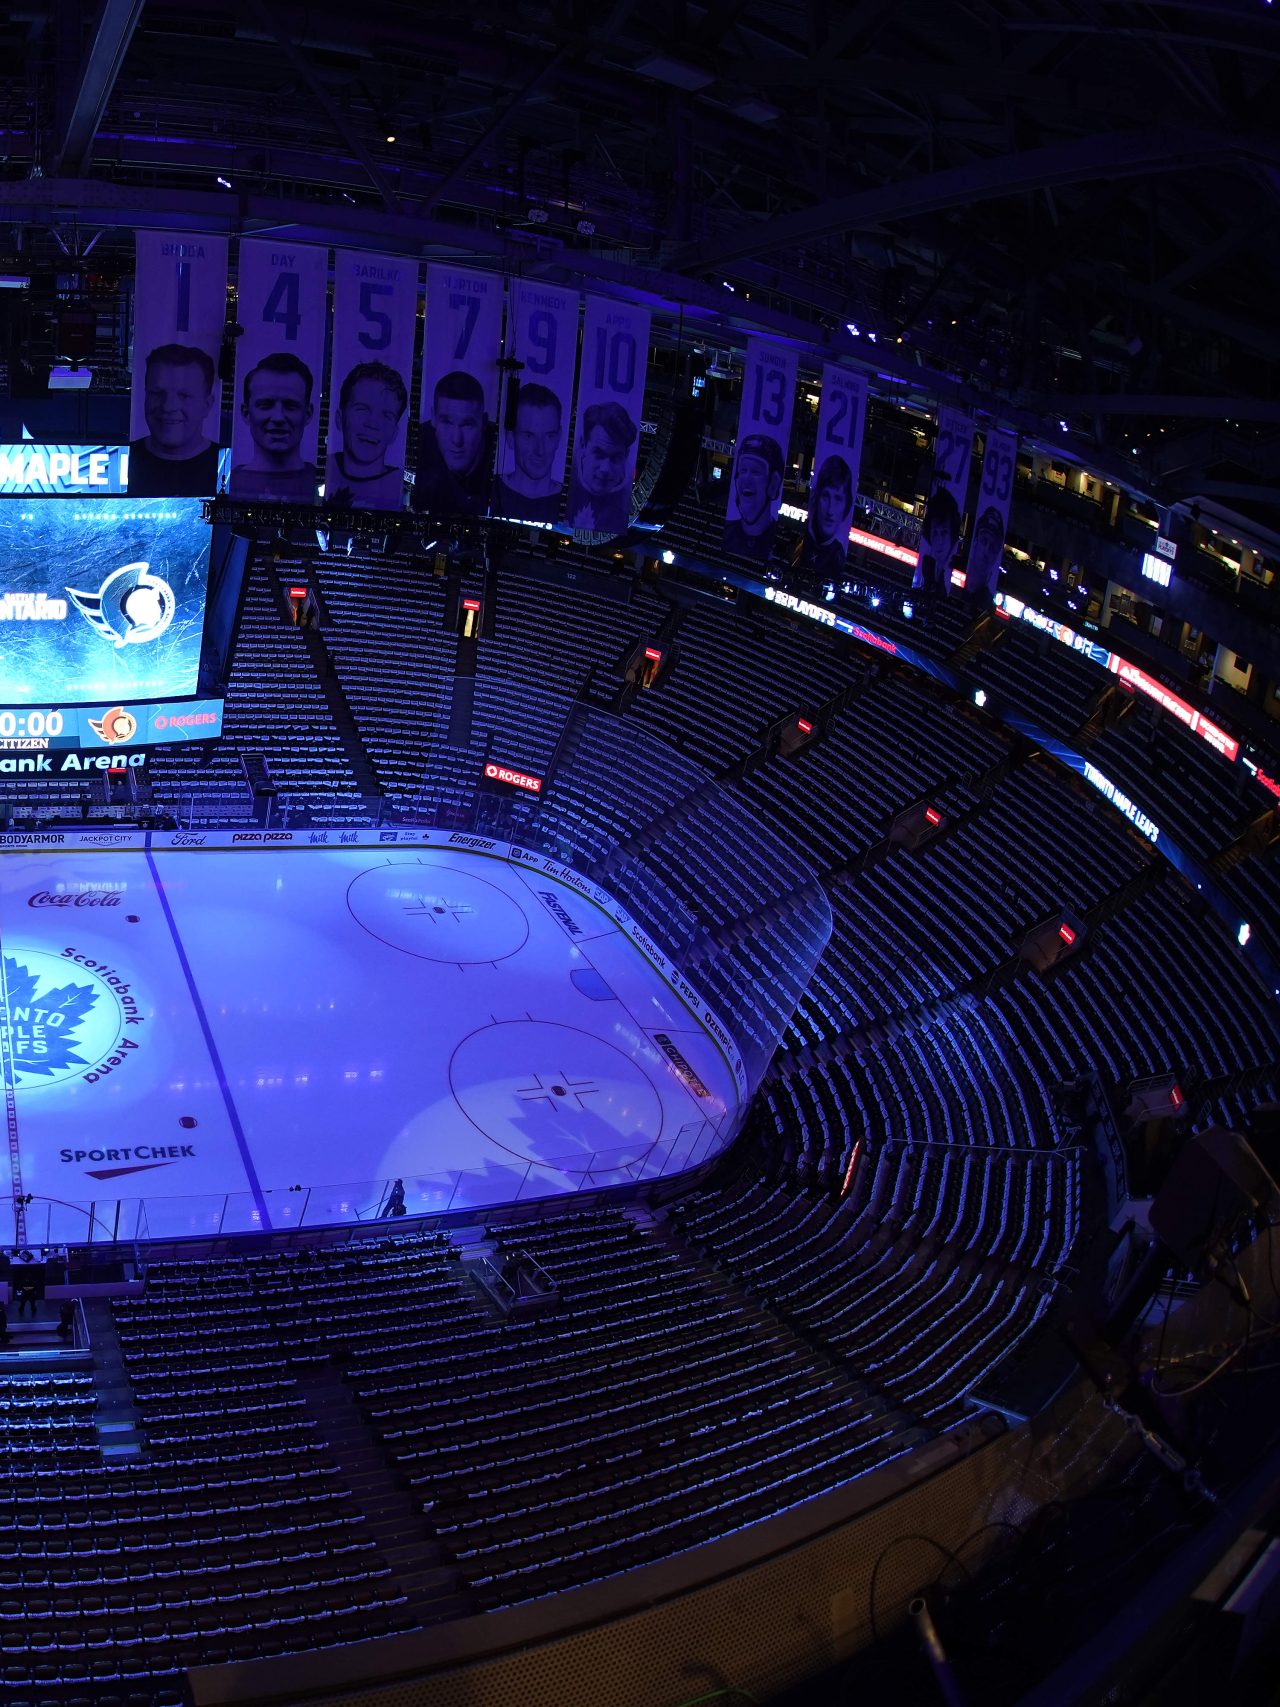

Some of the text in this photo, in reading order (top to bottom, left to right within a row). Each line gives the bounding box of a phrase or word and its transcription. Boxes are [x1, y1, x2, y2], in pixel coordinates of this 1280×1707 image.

[271, 253, 296, 268] DAY
[176, 262, 191, 332] 1
[263, 272, 301, 340] 4
[358, 282, 394, 350] 5
[449, 293, 481, 359] 7
[527, 310, 558, 374] 9
[595, 327, 636, 394] 10
[752, 364, 786, 426] 13
[826, 389, 859, 449] 21
[0, 453, 109, 486] MAPLE
[936, 431, 970, 485] 27
[983, 449, 1013, 501] 93
[169, 712, 217, 728] ROGERS
[61, 753, 146, 772] Arena
[499, 769, 540, 791] ROGERS
[1113, 789, 1138, 821] MAPLE
[1135, 810, 1160, 843] LEAFS
[0, 834, 65, 844] BODYARMOR
[79, 834, 133, 842] JACKPOT CITY
[171, 831, 207, 846] Ford
[232, 831, 293, 844] pizza pizza
[448, 832, 497, 850] Energizer
[542, 858, 591, 894] Tim Hortons
[632, 925, 666, 970] Scotiabank
[679, 981, 700, 1009] PEPSI
[60, 947, 144, 1084] Scotiabank Arena
[60, 1145, 196, 1163] SPORTCHEK
